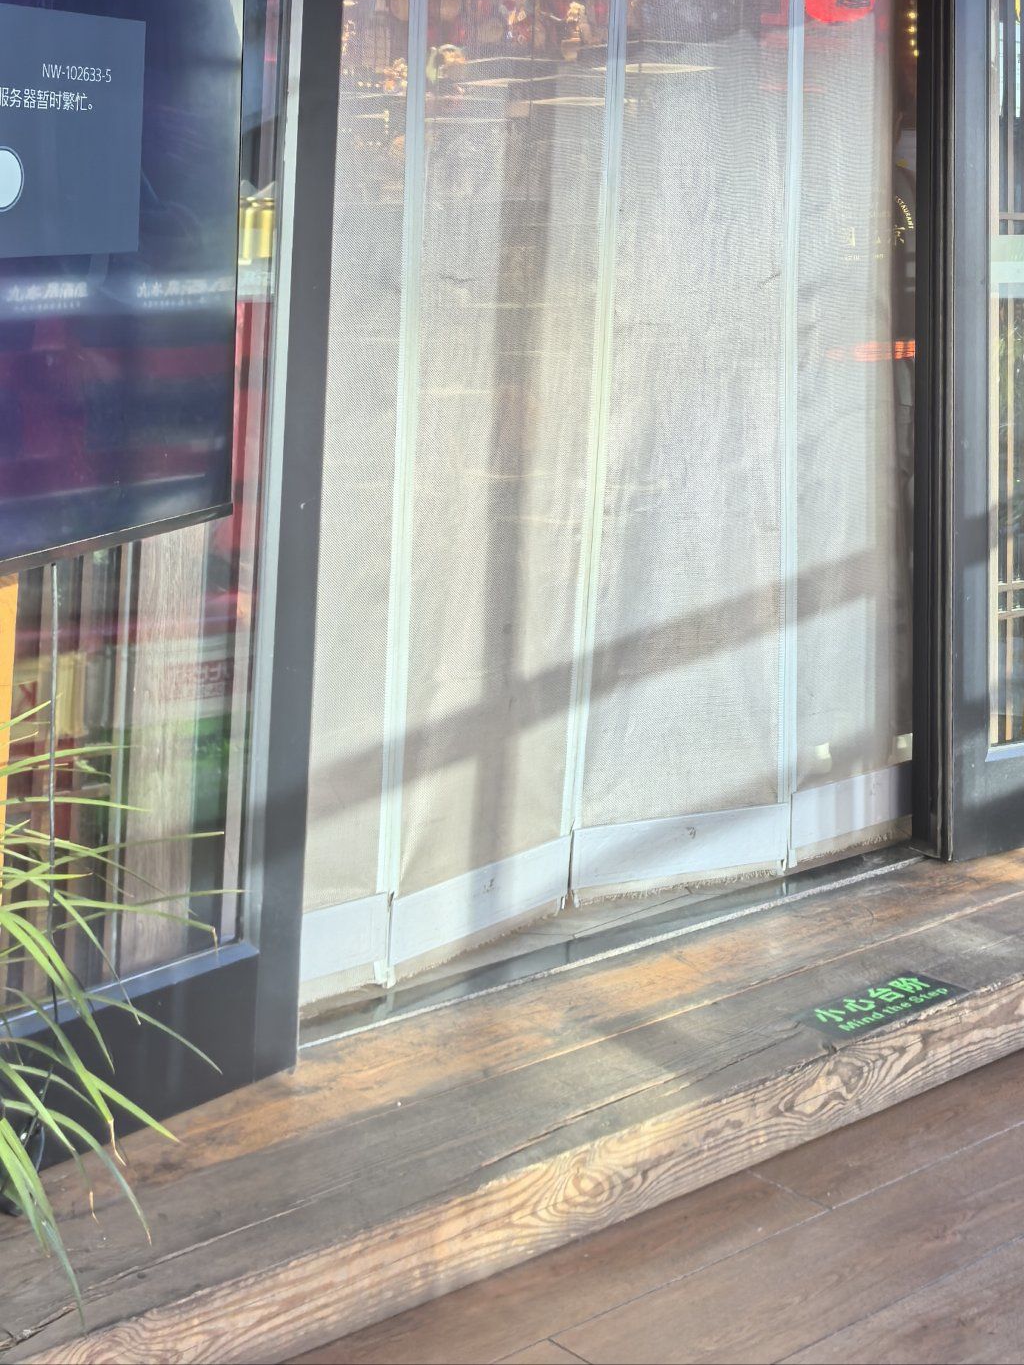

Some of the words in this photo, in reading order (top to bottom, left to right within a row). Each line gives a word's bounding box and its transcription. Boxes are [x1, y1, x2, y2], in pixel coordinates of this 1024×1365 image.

[42, 63, 112, 83] NW-102633-5
[838, 1011, 885, 1032] Mind
[882, 1001, 912, 1014] the
[908, 987, 948, 1004] Step
